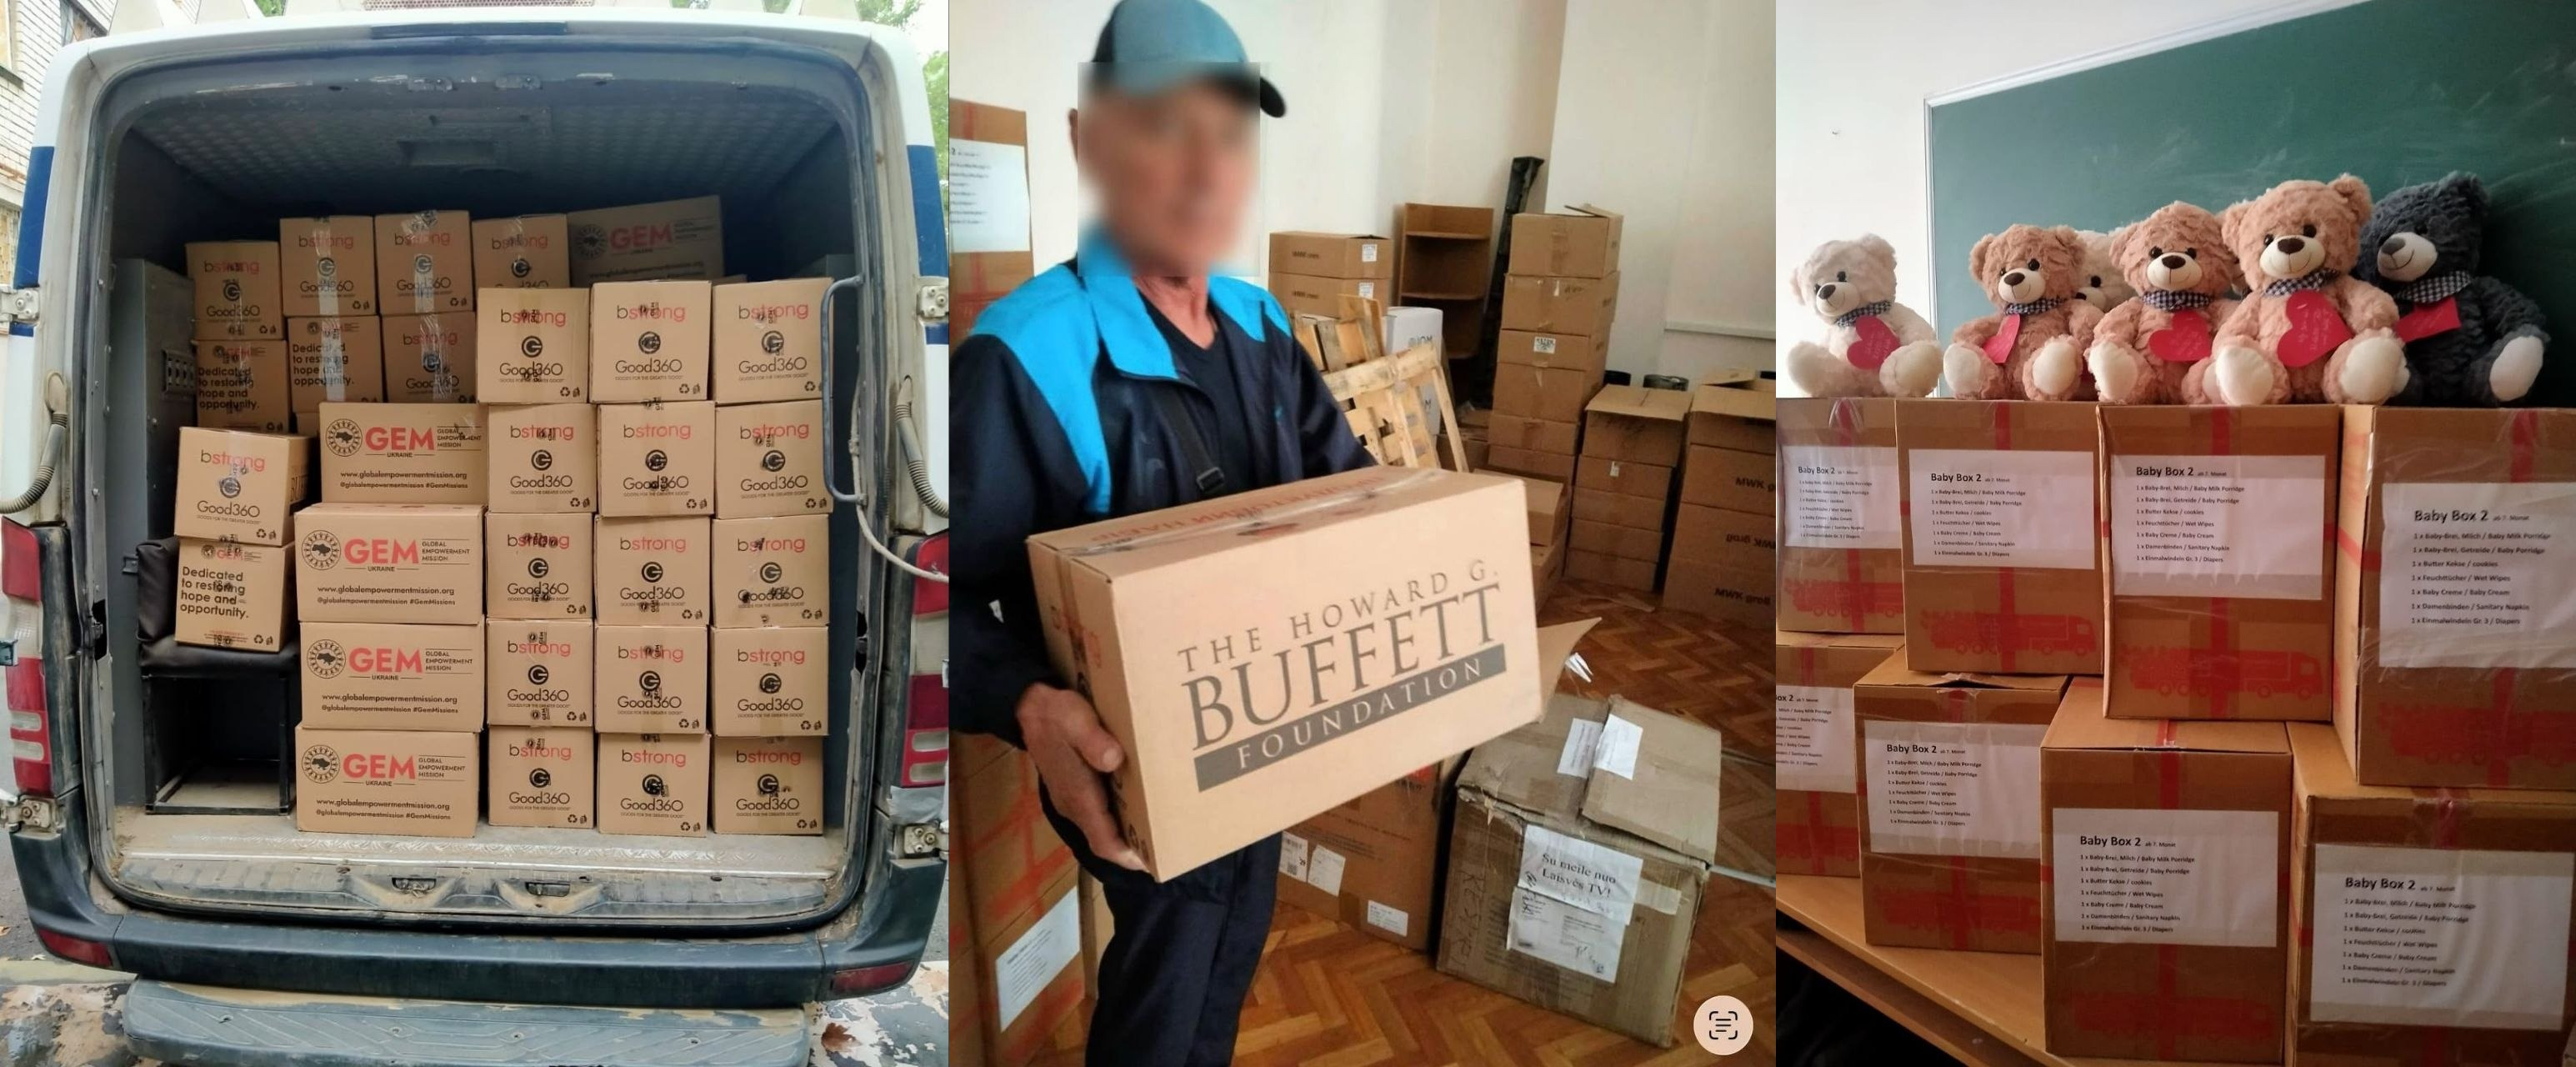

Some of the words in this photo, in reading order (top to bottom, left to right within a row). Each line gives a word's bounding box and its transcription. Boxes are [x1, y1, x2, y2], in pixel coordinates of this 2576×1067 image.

[609, 223, 673, 250] GEM
[294, 366, 319, 375] hope
[615, 358, 683, 373] Good360
[739, 357, 807, 373] Good360
[198, 389, 228, 400] hope
[228, 389, 248, 398] and
[623, 423, 691, 439] bstrong
[740, 423, 809, 439] bstrong
[365, 427, 434, 451] GEM
[341, 471, 468, 480] www.globalempowermentmission.org
[1798, 466, 1814, 474] Baby
[2136, 466, 2162, 478] Baby
[2165, 467, 2185, 476] Box
[2188, 467, 2193, 476] 2
[510, 474, 573, 488] Good360
[741, 475, 808, 492] Good360
[1735, 477, 1763, 488] MWK
[1931, 473, 1953, 483] Baby
[1957, 473, 1973, 482] Box
[1976, 473, 1982, 482] 2
[197, 500, 260, 518] Good360
[2414, 510, 2448, 523] Baby
[2452, 510, 2477, 521] Box
[2481, 510, 2488, 521] 2
[344, 539, 418, 564] GEM
[620, 537, 686, 553] bstrong
[183, 566, 243, 582] Dedicated
[182, 578, 193, 589] to
[318, 585, 454, 595] www.globalempowermentmission.org
[507, 582, 569, 595] Good360
[181, 590, 210, 603] hope
[214, 595, 237, 604] and
[620, 586, 684, 600] Good360
[1714, 587, 1743, 599] MWK
[180, 604, 248, 619] opportunity.
[1177, 628, 1263, 673] THE
[1288, 572, 1448, 640] HOWARD
[1469, 559, 1499, 580] G.
[508, 640, 571, 657] bstrong
[348, 648, 423, 673] GEM
[738, 649, 805, 664] bstrong
[1180, 584, 1501, 751] BUFFETT
[322, 694, 458, 704] www.globalempowermentmission.org
[507, 689, 569, 702] Good360
[618, 695, 682, 709] Good360
[738, 698, 803, 711] Good360
[1237, 658, 1484, 769] FOUNDATION
[509, 744, 571, 761] bstrong
[1887, 744, 1909, 754] Baby
[1912, 744, 1928, 754] Box
[1932, 745, 1937, 754] 2
[622, 750, 686, 768] bstrong
[736, 749, 801, 765] bstrong
[343, 754, 415, 779] GEM
[316, 799, 449, 810] www.globalempowermentmission.org
[509, 792, 570, 804] Good360
[621, 798, 683, 812] Good360
[736, 798, 799, 810] Good360
[2080, 835, 2108, 847] Baby
[2111, 837, 2131, 846] Box
[2134, 837, 2141, 846] 2
[1543, 853, 1556, 866] Su
[1588, 883, 1611, 899] TV!
[2345, 878, 2377, 890] Baby
[2381, 879, 2404, 889] Box
[2408, 879, 2416, 890] 2
